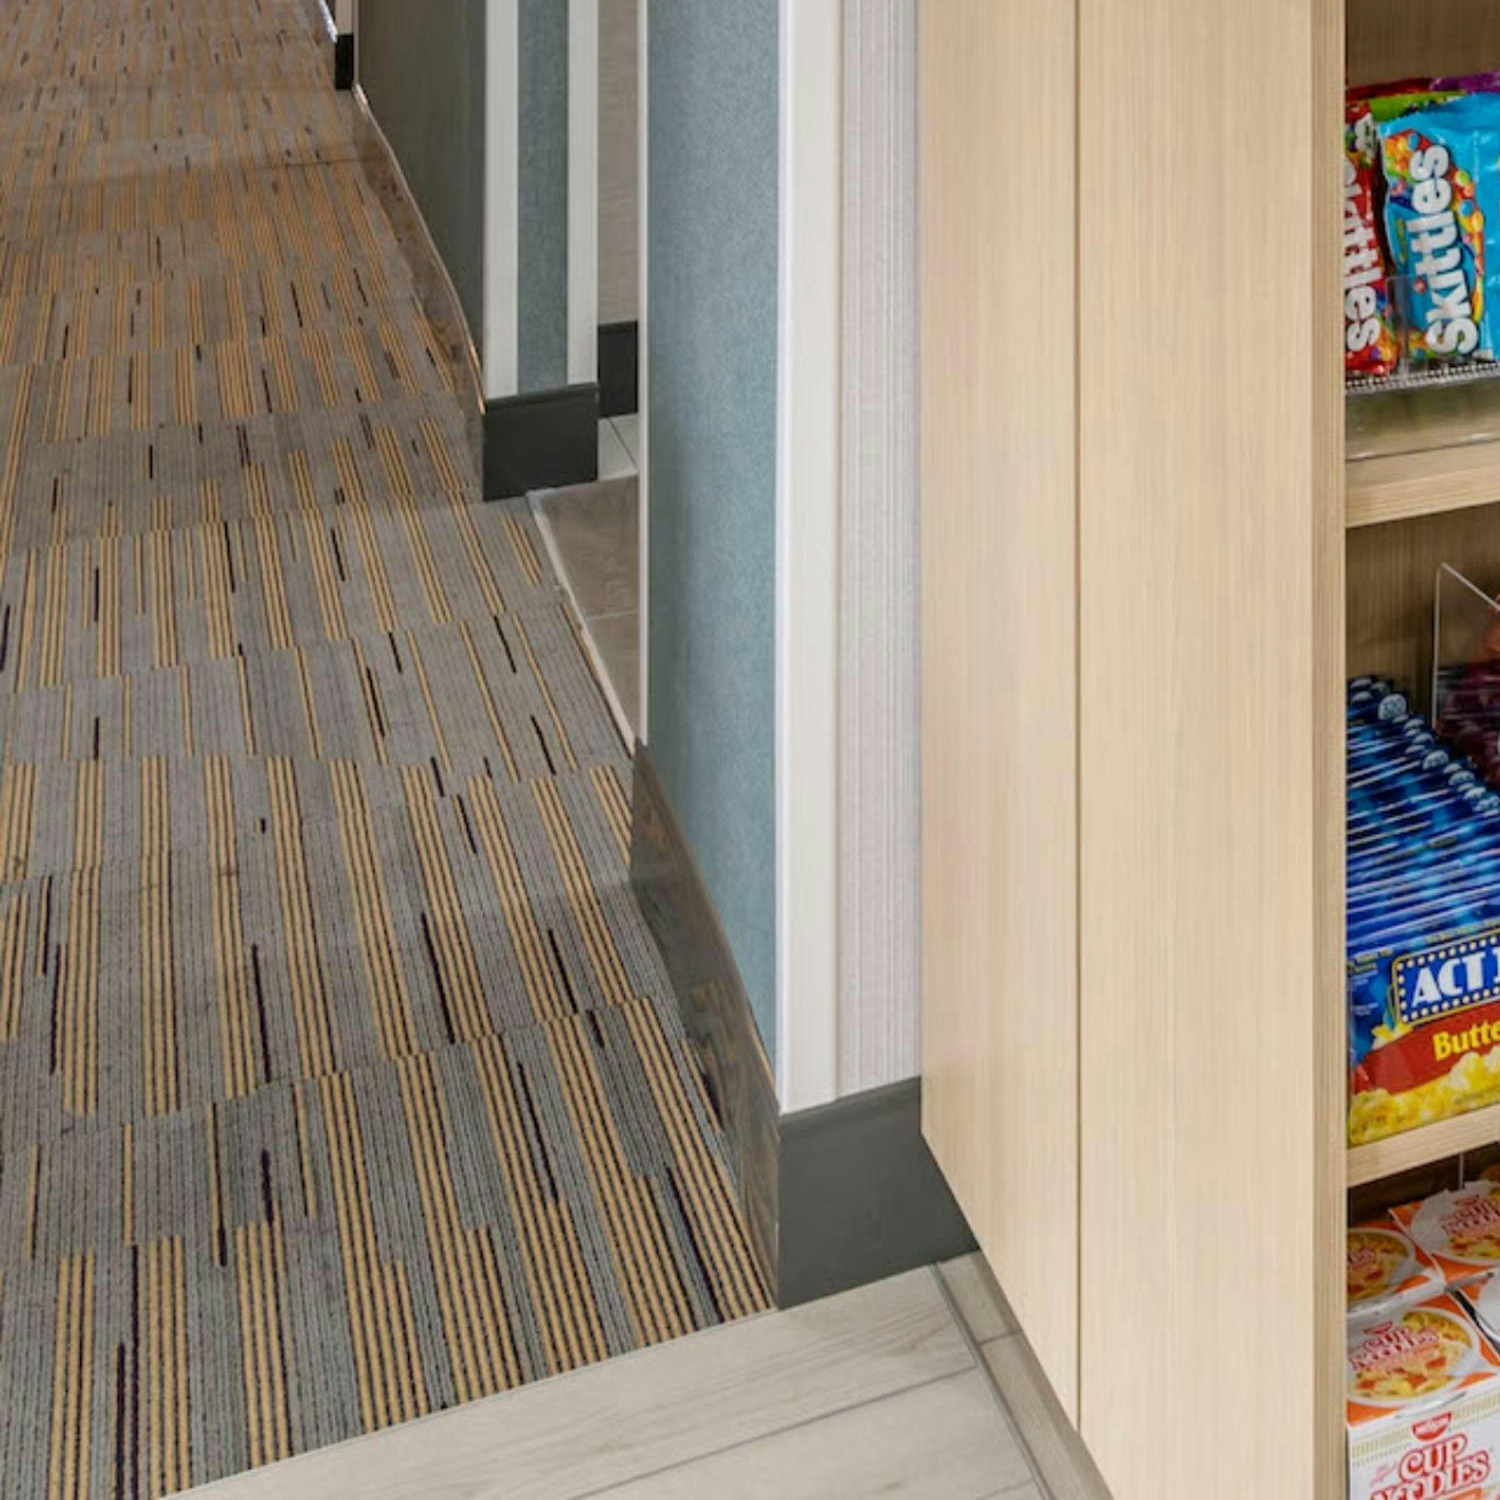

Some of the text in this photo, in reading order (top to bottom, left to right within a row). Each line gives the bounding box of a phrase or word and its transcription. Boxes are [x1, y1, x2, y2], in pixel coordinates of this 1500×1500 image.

[1407, 145, 1479, 354] Skittles
[1411, 951, 1487, 1008] ACT
[1371, 1449, 1490, 1500] NOODLES
[1399, 1434, 1468, 1482] CUP
